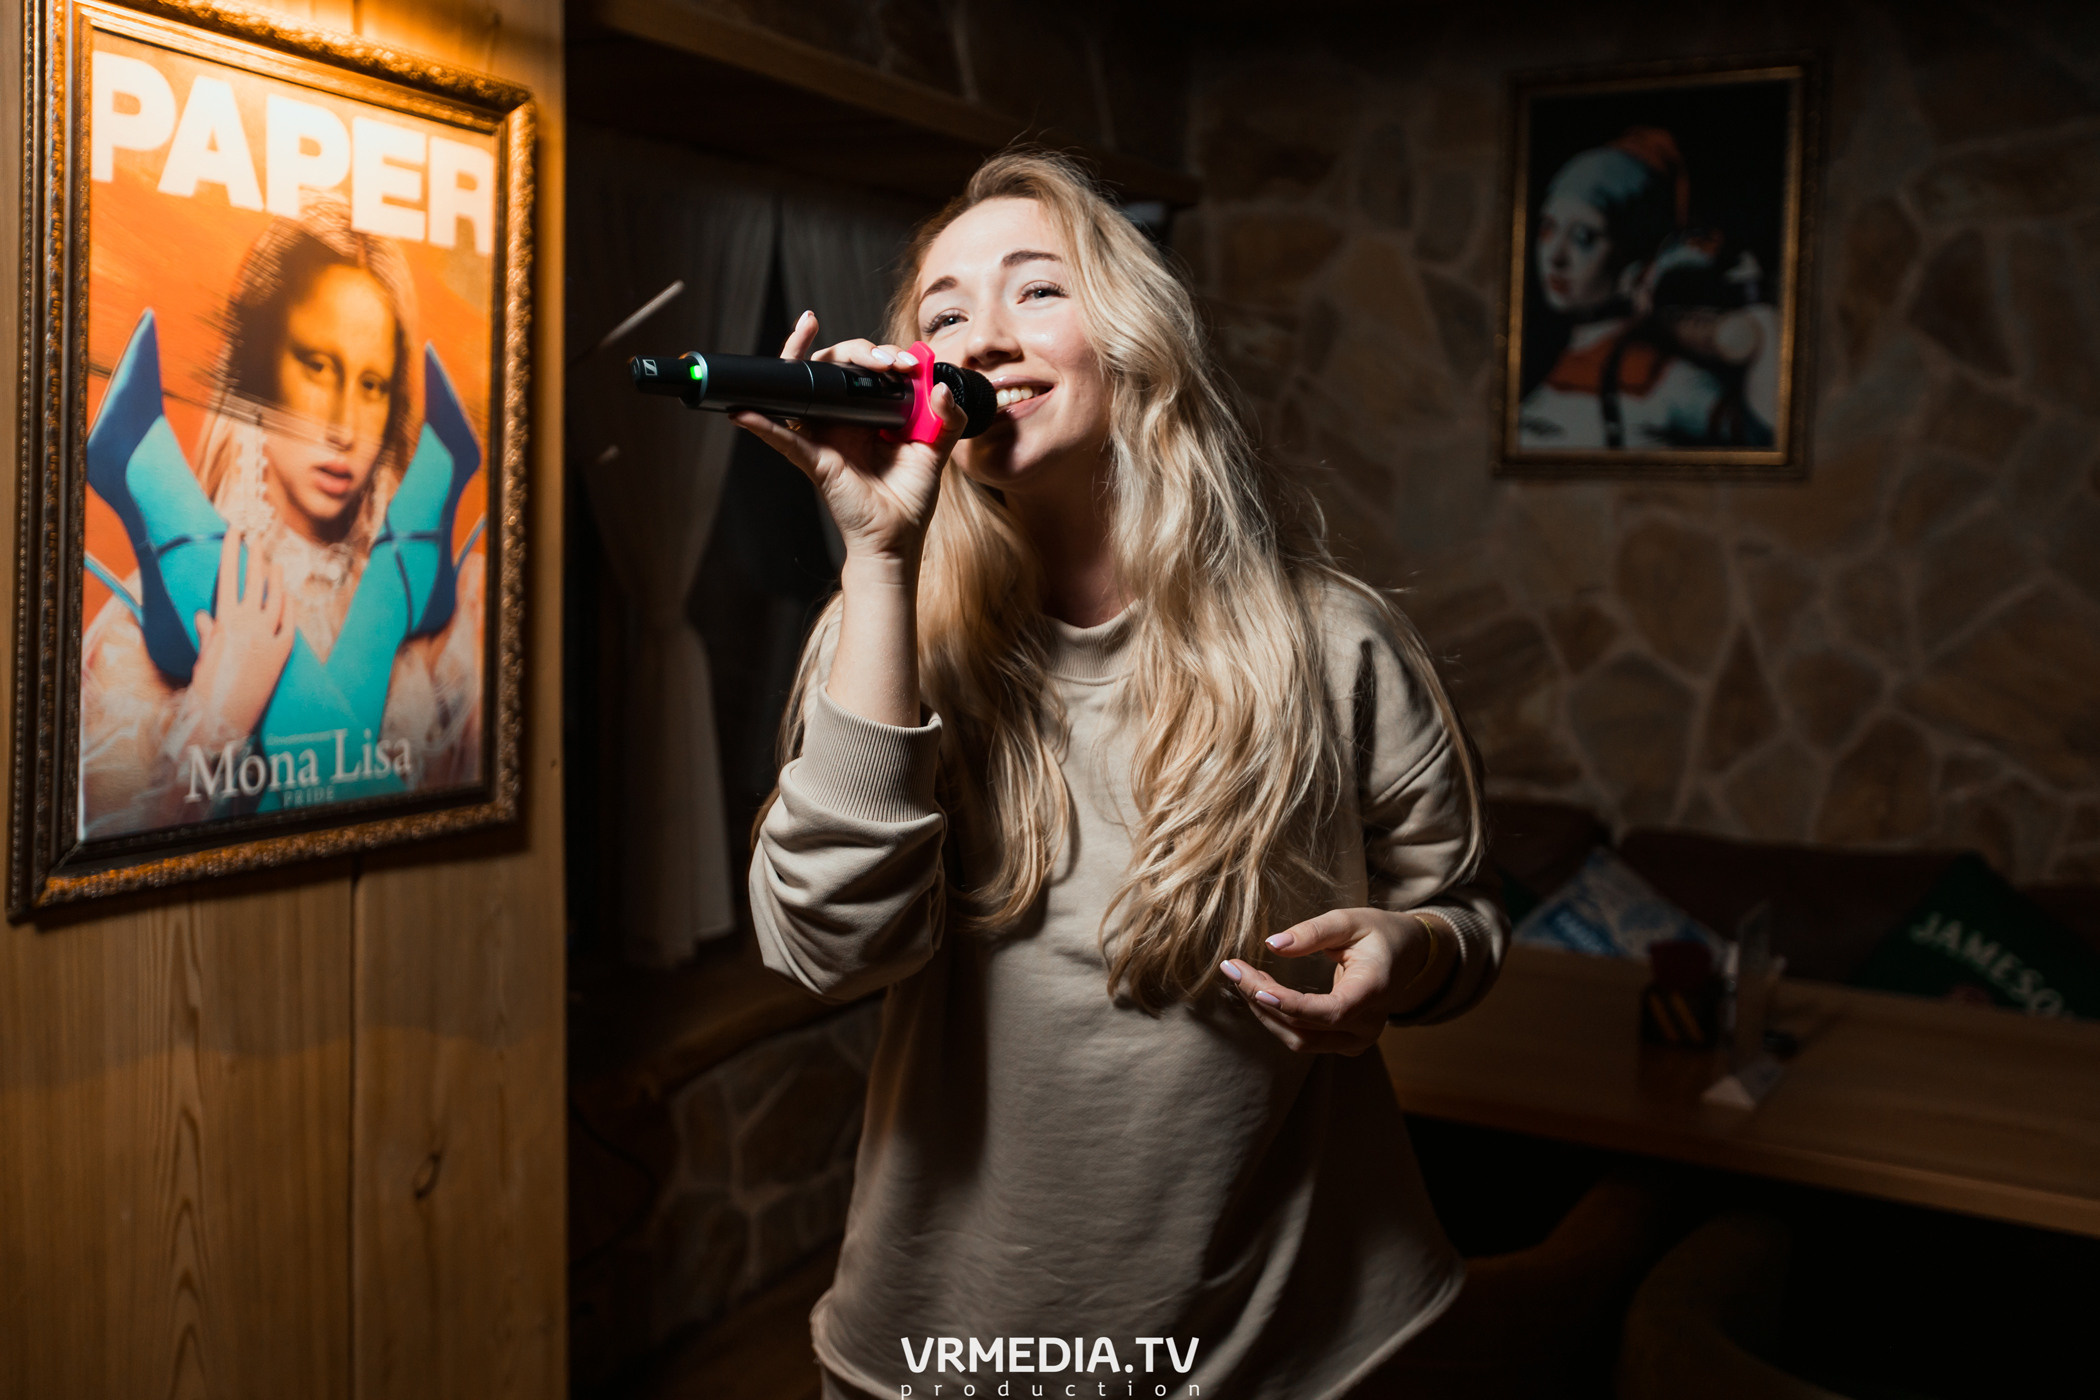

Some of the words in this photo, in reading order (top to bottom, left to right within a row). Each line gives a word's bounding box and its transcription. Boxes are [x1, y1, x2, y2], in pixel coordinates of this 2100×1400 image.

[92, 50, 495, 256] PAPER
[185, 743, 321, 802] Mona
[330, 728, 412, 784] Lisa
[1909, 911, 2076, 1022] JAMESO
